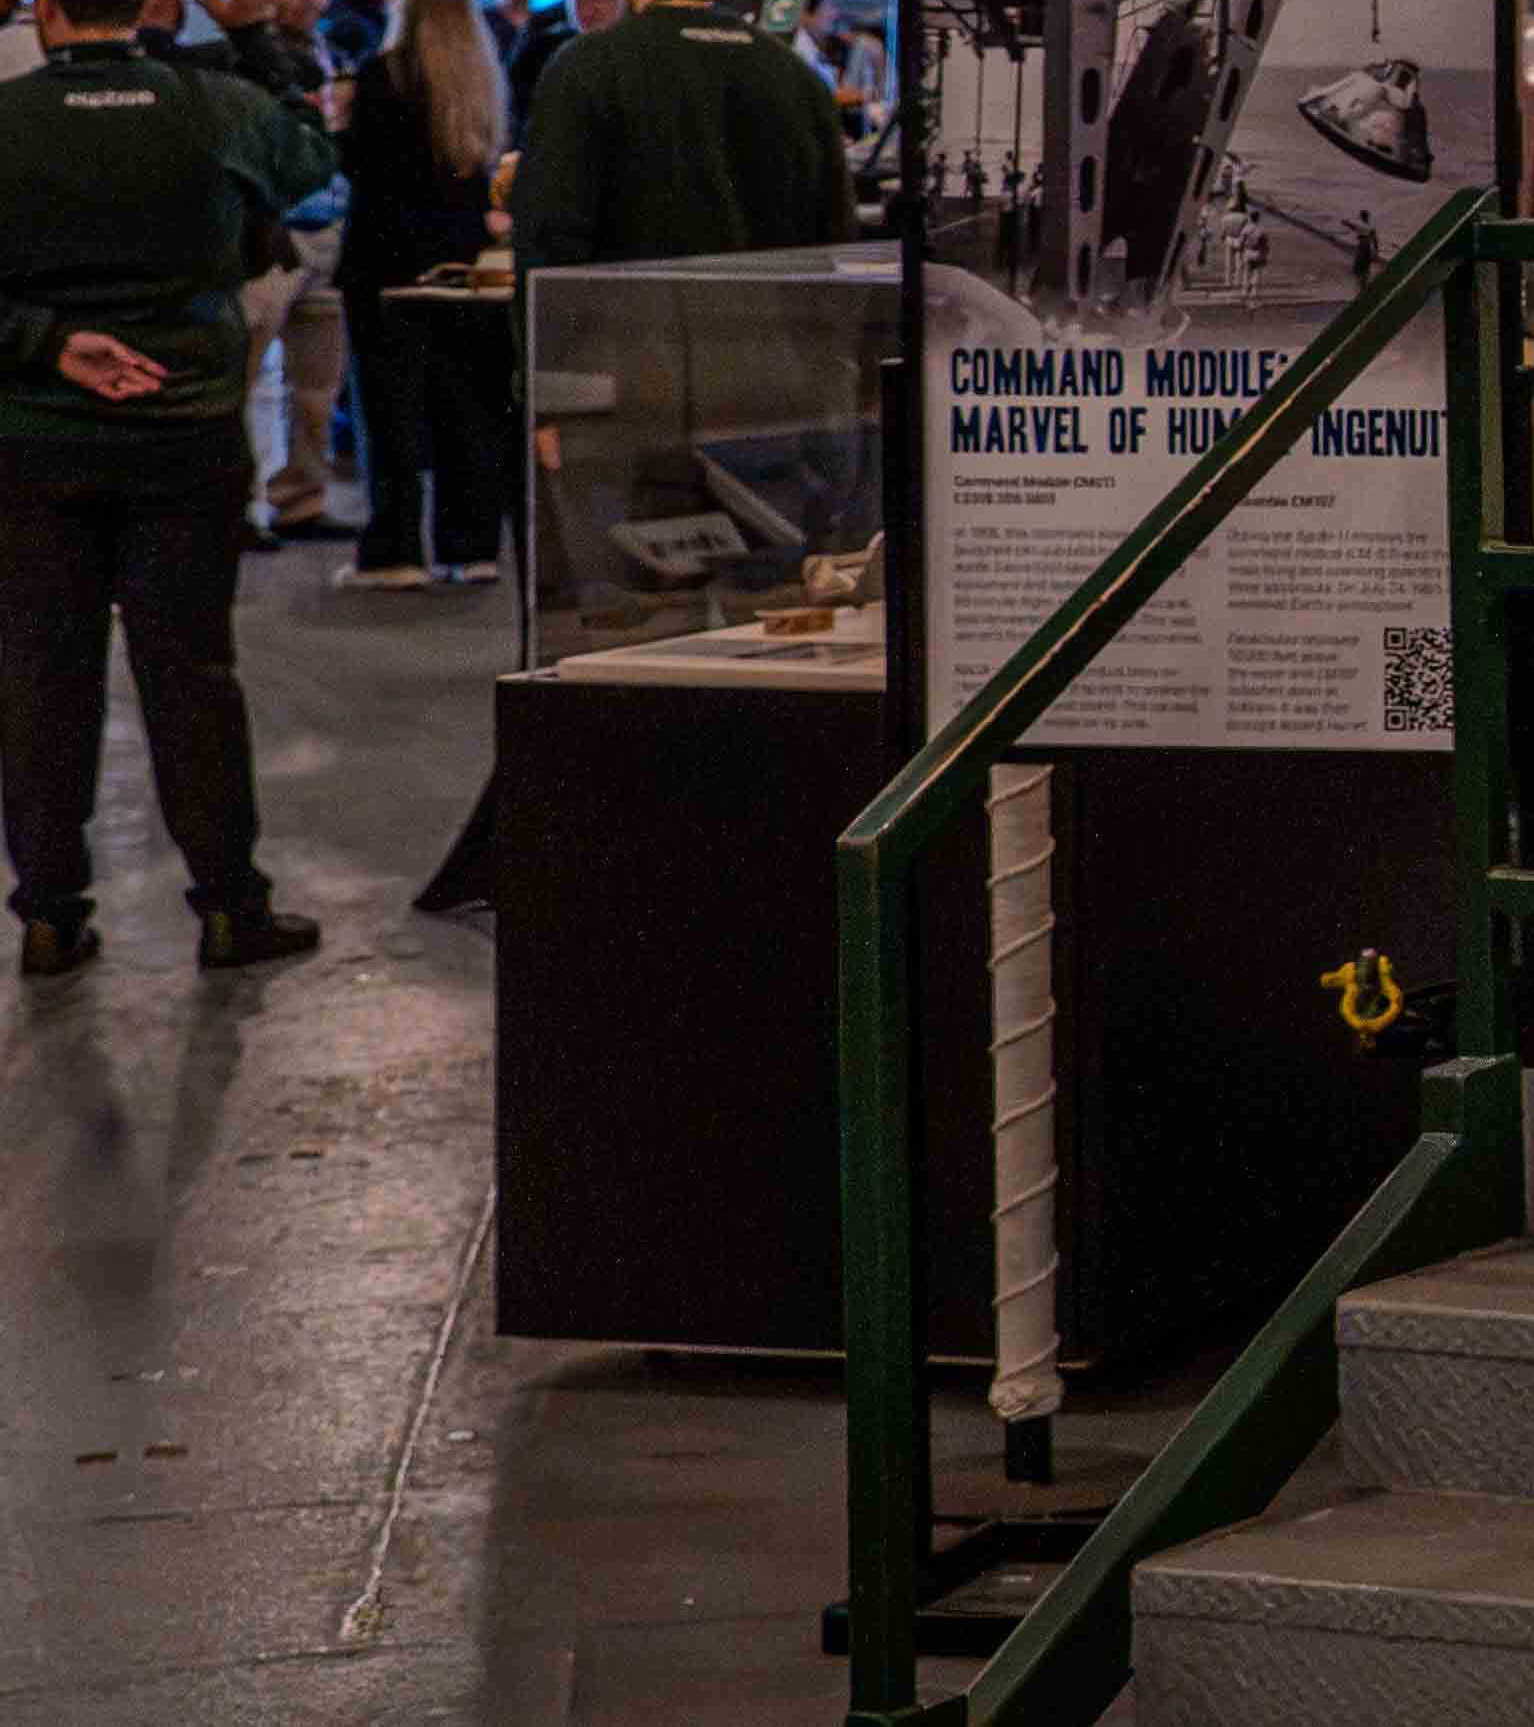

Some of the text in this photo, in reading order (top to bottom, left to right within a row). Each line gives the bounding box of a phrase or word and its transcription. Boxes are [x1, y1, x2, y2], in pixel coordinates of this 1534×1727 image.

[951, 348, 1123, 396] COMMAND
[951, 406, 1088, 454] MARVEL
[1109, 406, 1147, 454] OF
[1311, 409, 1446, 456] INGENUI
